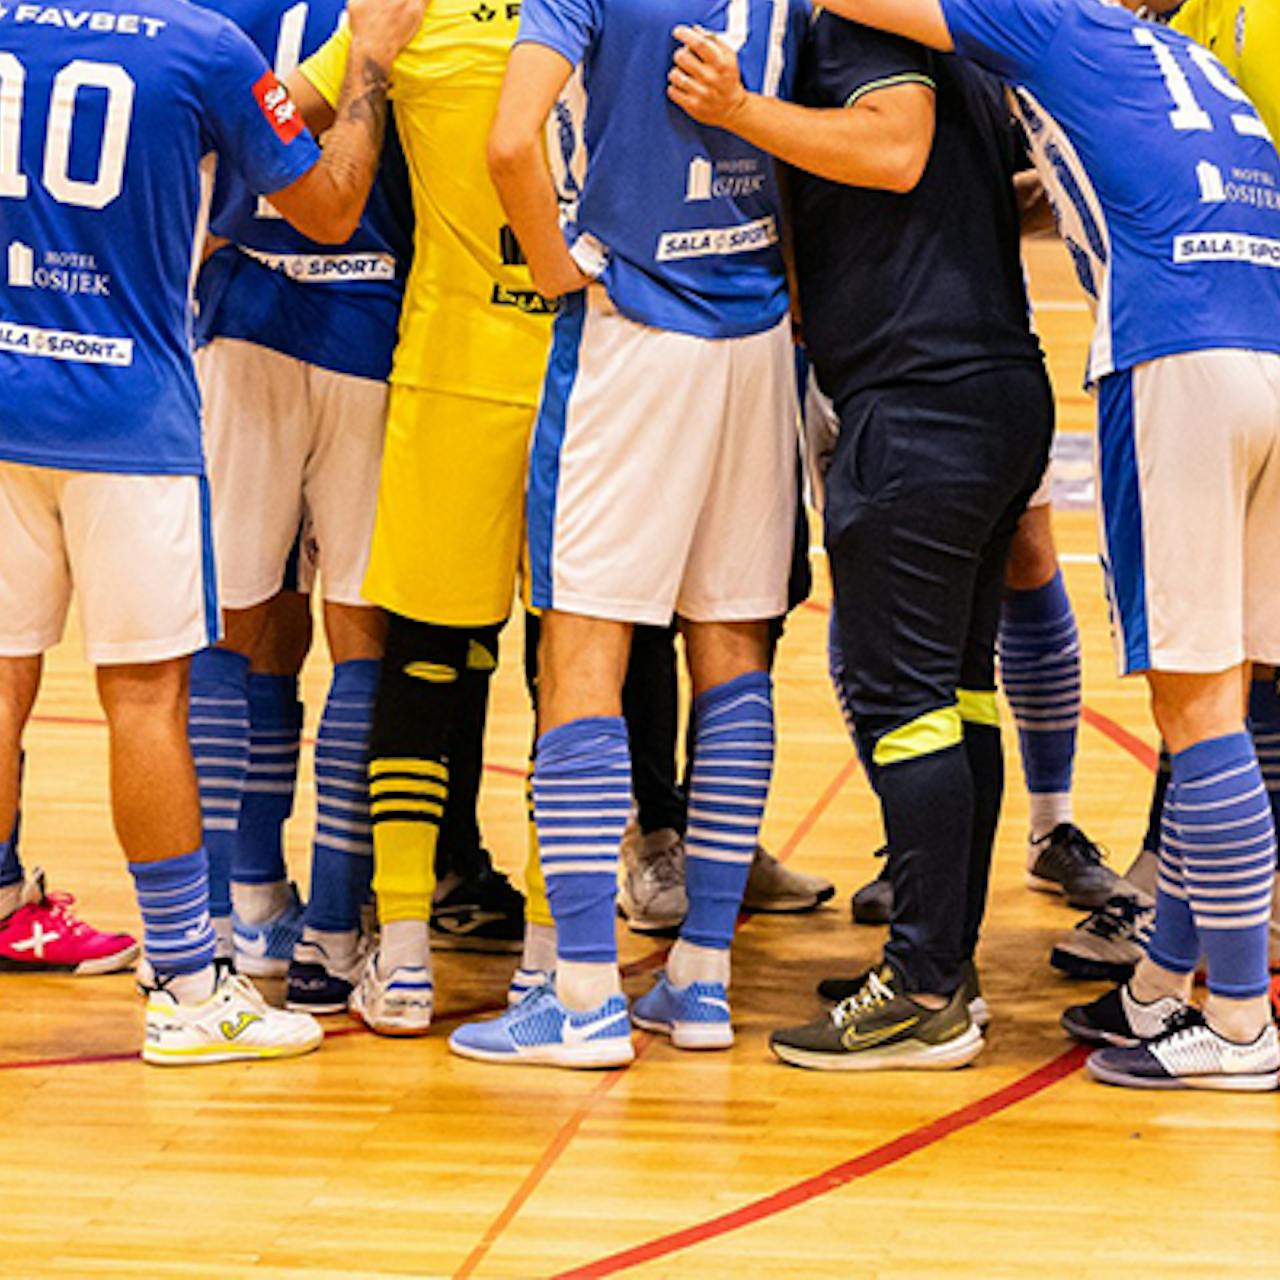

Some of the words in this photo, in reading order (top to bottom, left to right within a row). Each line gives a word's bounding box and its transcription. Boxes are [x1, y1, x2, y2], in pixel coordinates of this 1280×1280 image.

[15, 4, 166, 38] FAVBET
[665, 234, 711, 255] SALA
[1181, 239, 1234, 257] SALA
[44, 250, 96, 270] HOTEL
[307, 257, 378, 276] SPORT
[33, 267, 111, 297] OSIJEK
[47, 335, 118, 358] SPORT
